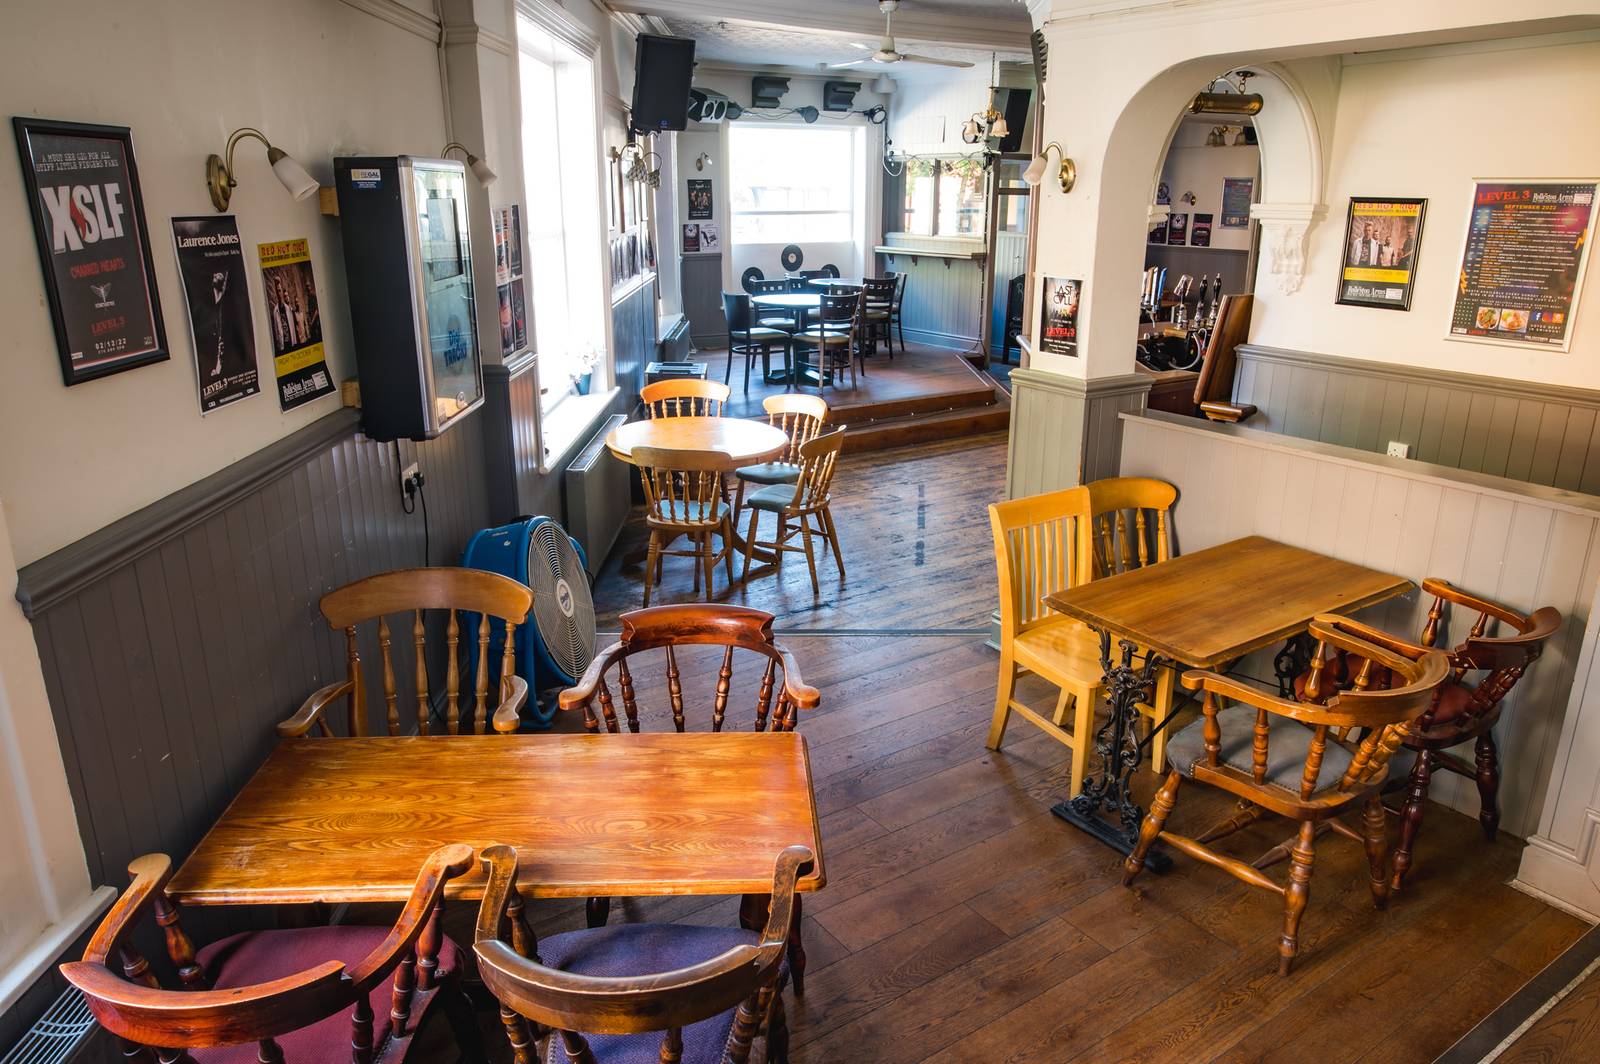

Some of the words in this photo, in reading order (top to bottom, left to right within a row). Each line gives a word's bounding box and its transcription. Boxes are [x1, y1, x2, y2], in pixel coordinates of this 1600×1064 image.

[1477, 190, 1520, 204] LEVEL
[1521, 189, 1531, 200] 3
[40, 182, 124, 251] XSLF
[177, 235, 216, 248] Laurence
[217, 233, 239, 245] Jones
[203, 380, 224, 397] LEVEL
